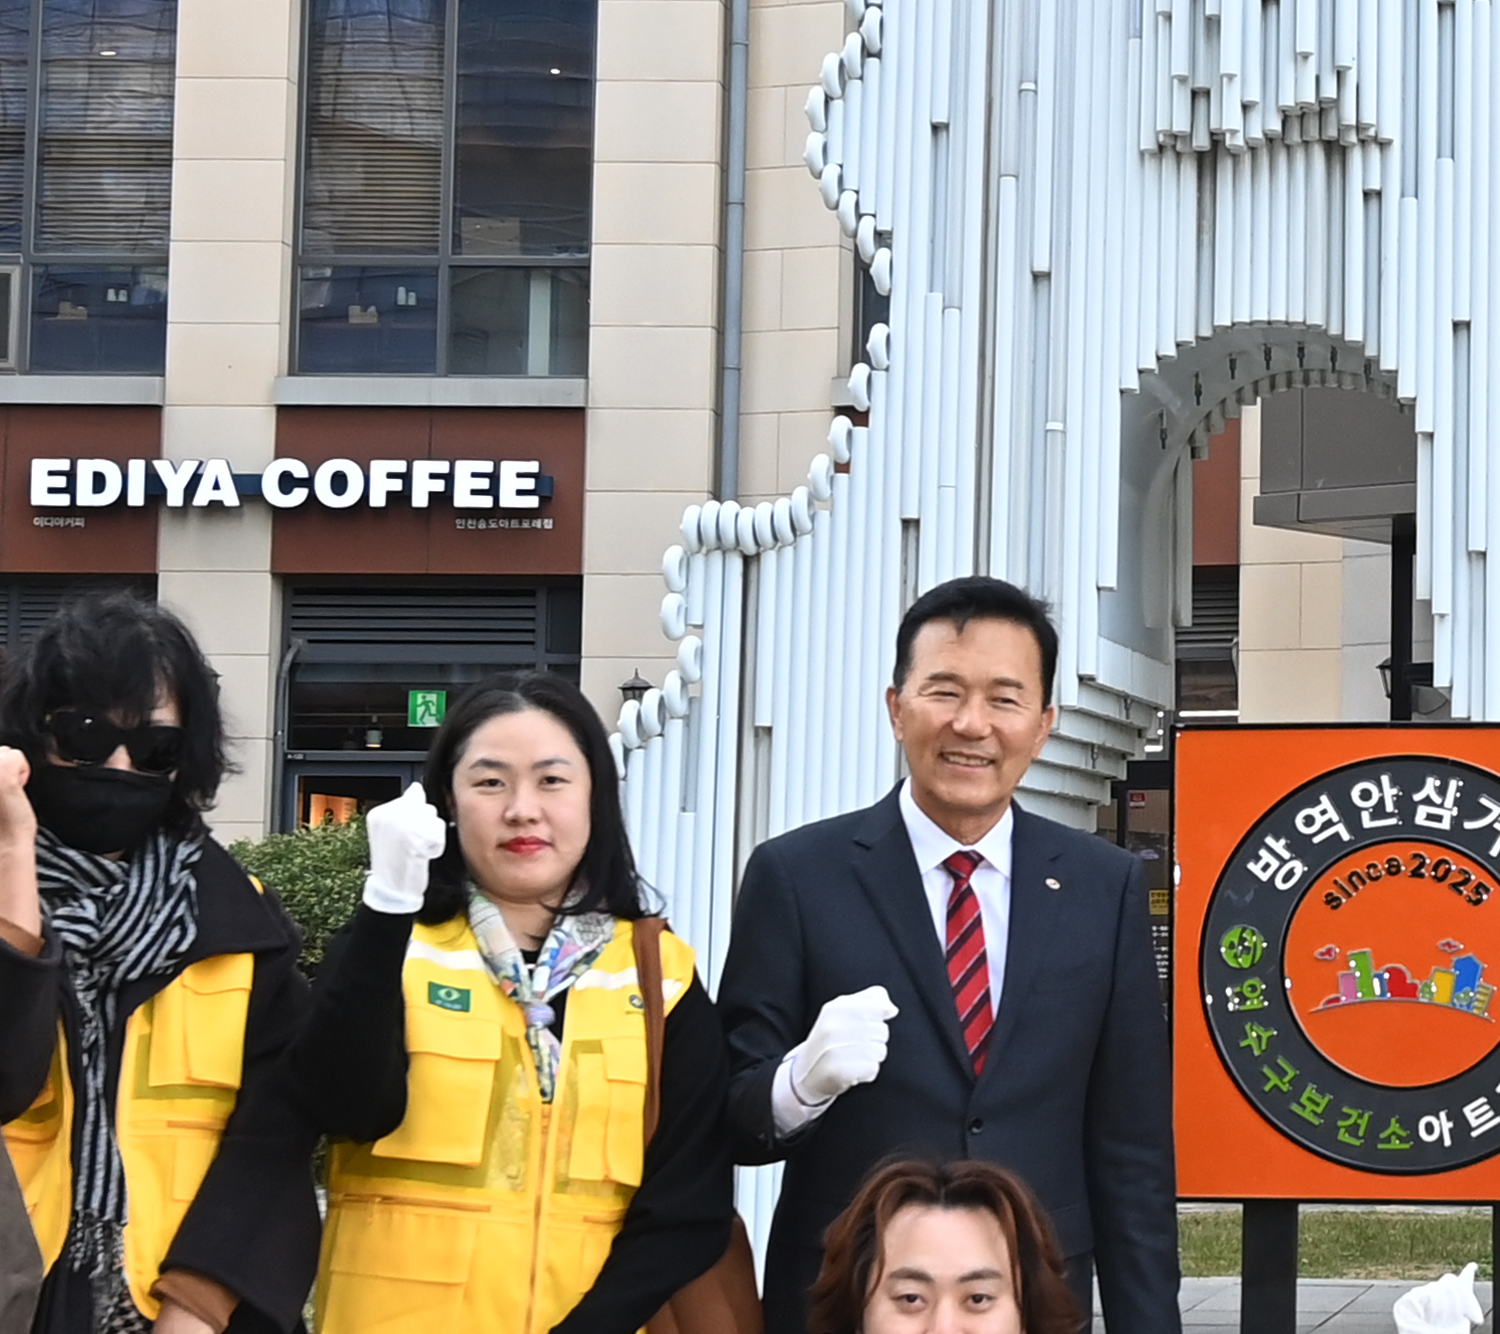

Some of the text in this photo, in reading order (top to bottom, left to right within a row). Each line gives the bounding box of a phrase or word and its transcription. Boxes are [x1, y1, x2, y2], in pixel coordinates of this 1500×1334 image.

[30, 457, 542, 510] EDIYA COFFEE
[1323, 851, 1493, 911] since 2025
